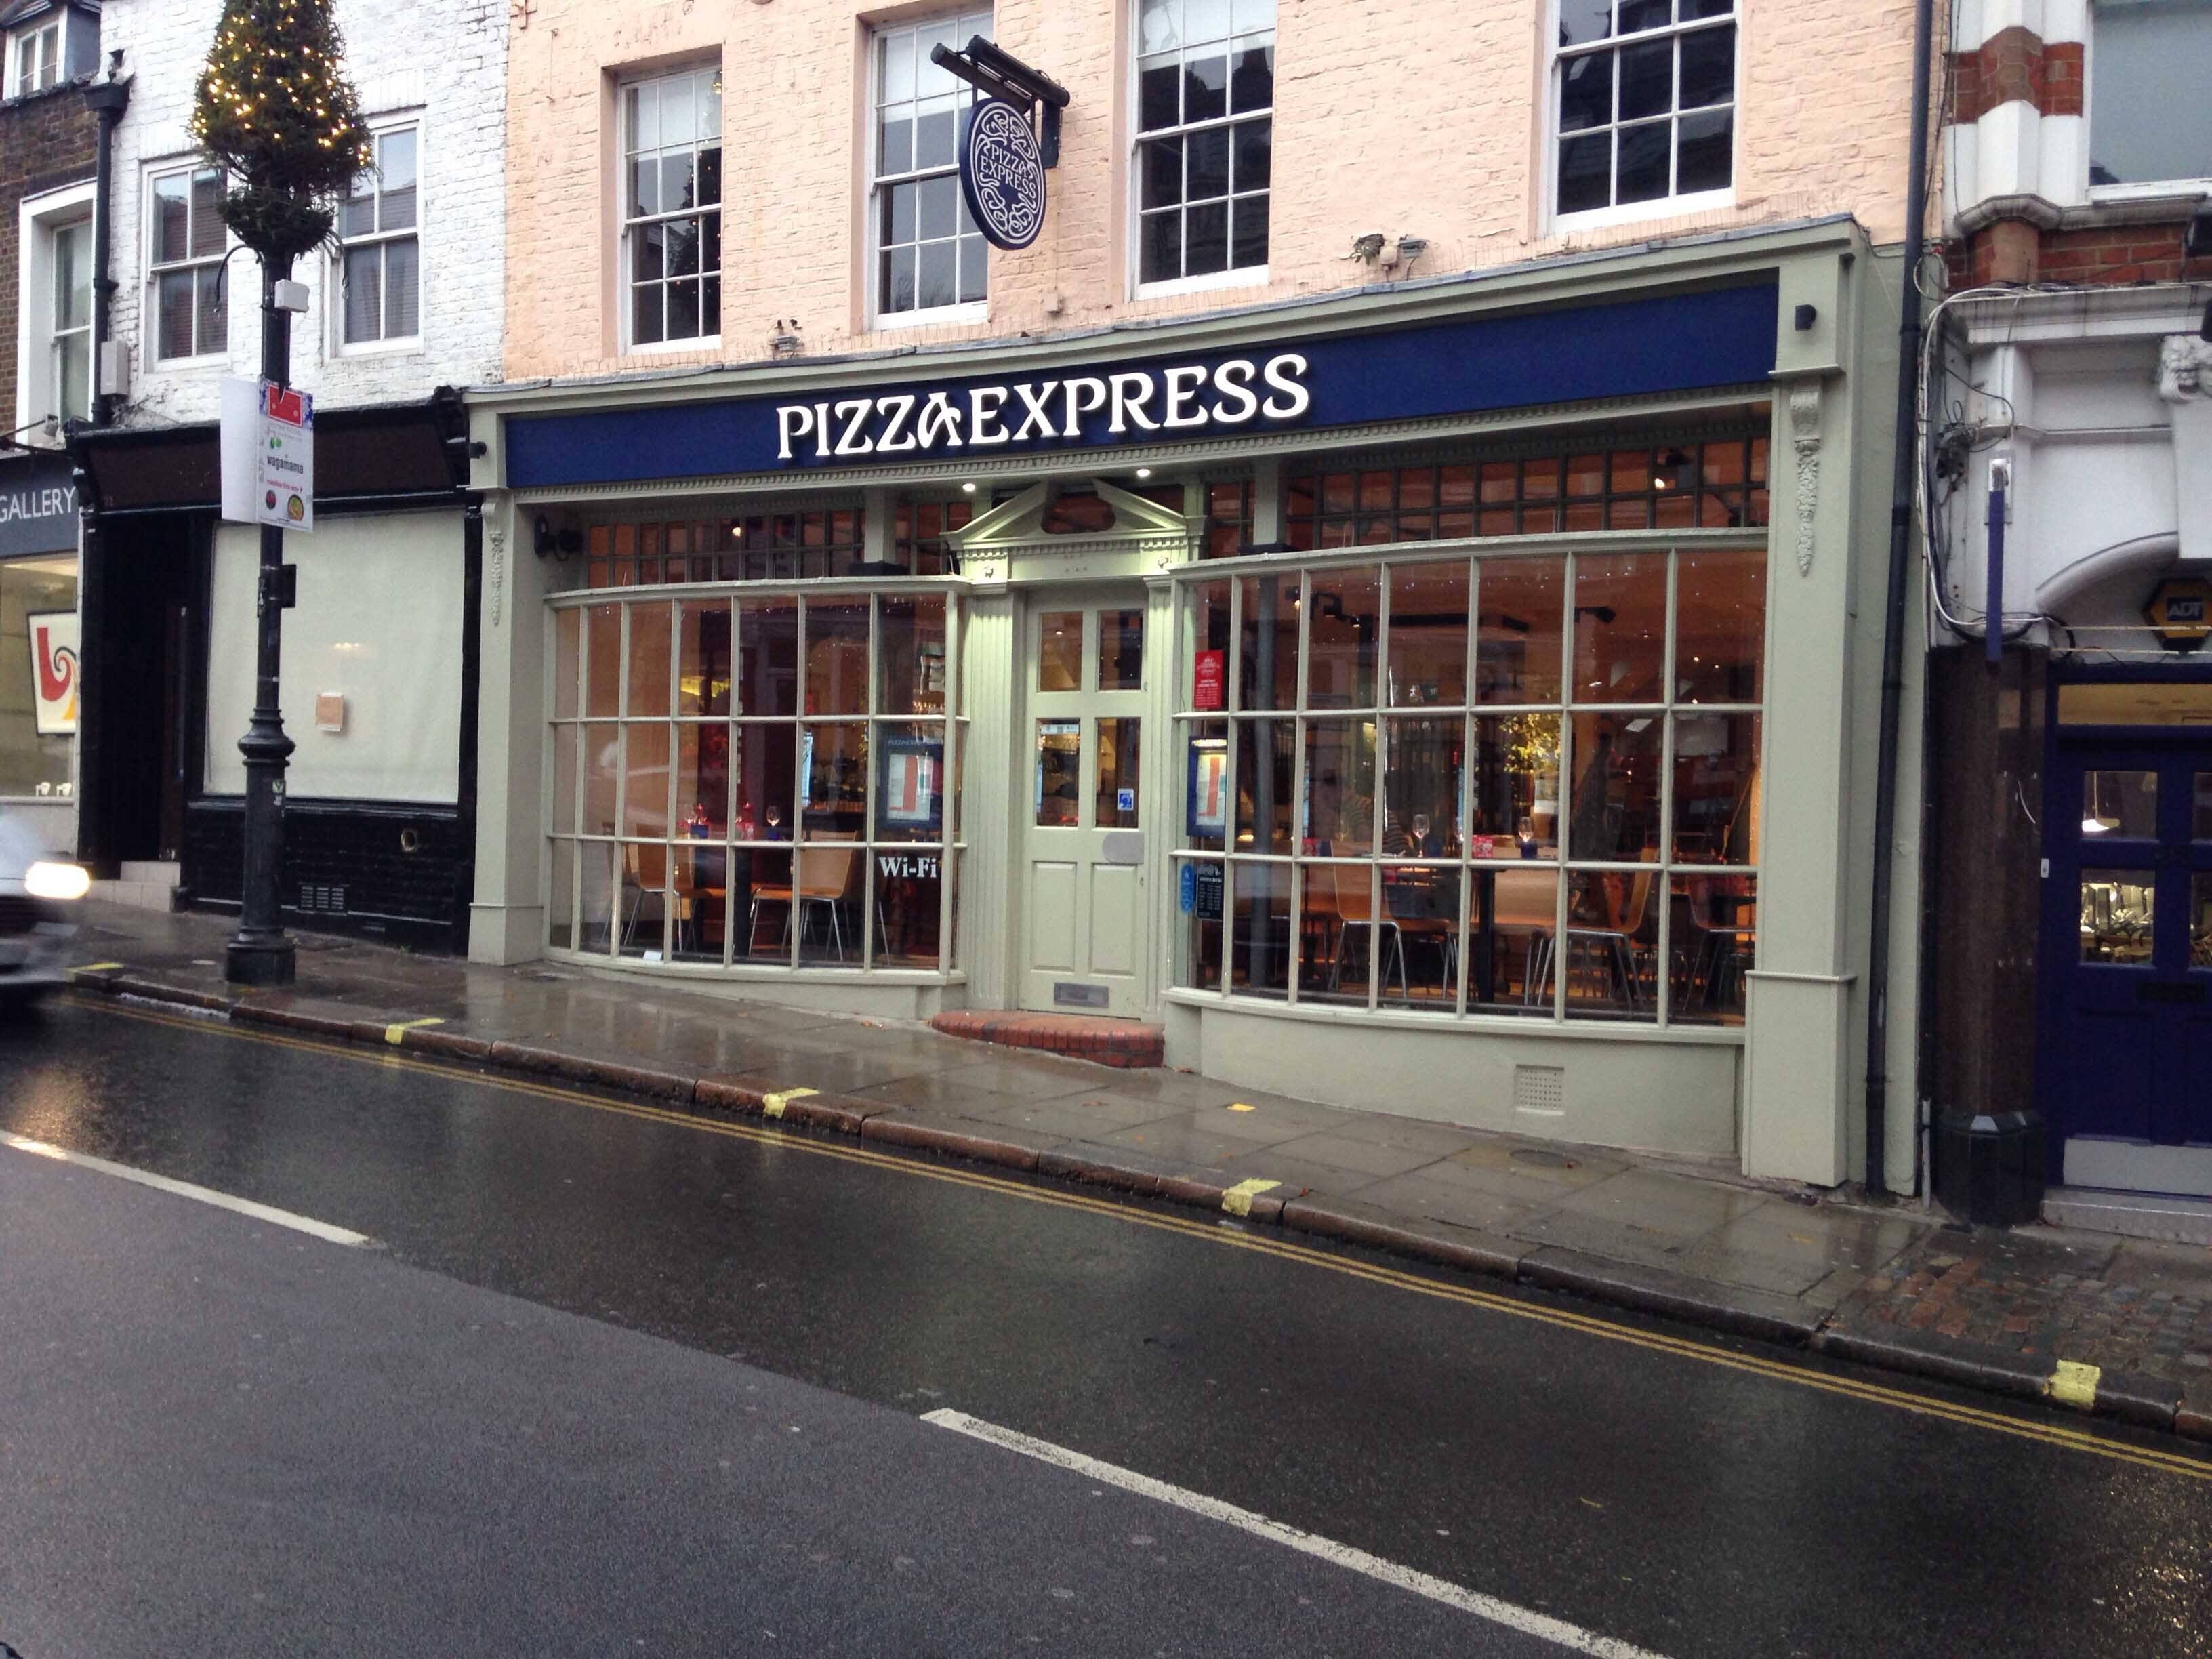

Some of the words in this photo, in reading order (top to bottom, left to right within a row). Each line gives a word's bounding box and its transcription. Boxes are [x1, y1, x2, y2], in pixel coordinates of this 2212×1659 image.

[981, 155, 1036, 199] EXPRESS
[991, 144, 1027, 178] PIZZA
[0, 486, 76, 523] GALLERY
[2168, 602, 2203, 617] ADT
[878, 856, 937, 878] Wi-Fi
